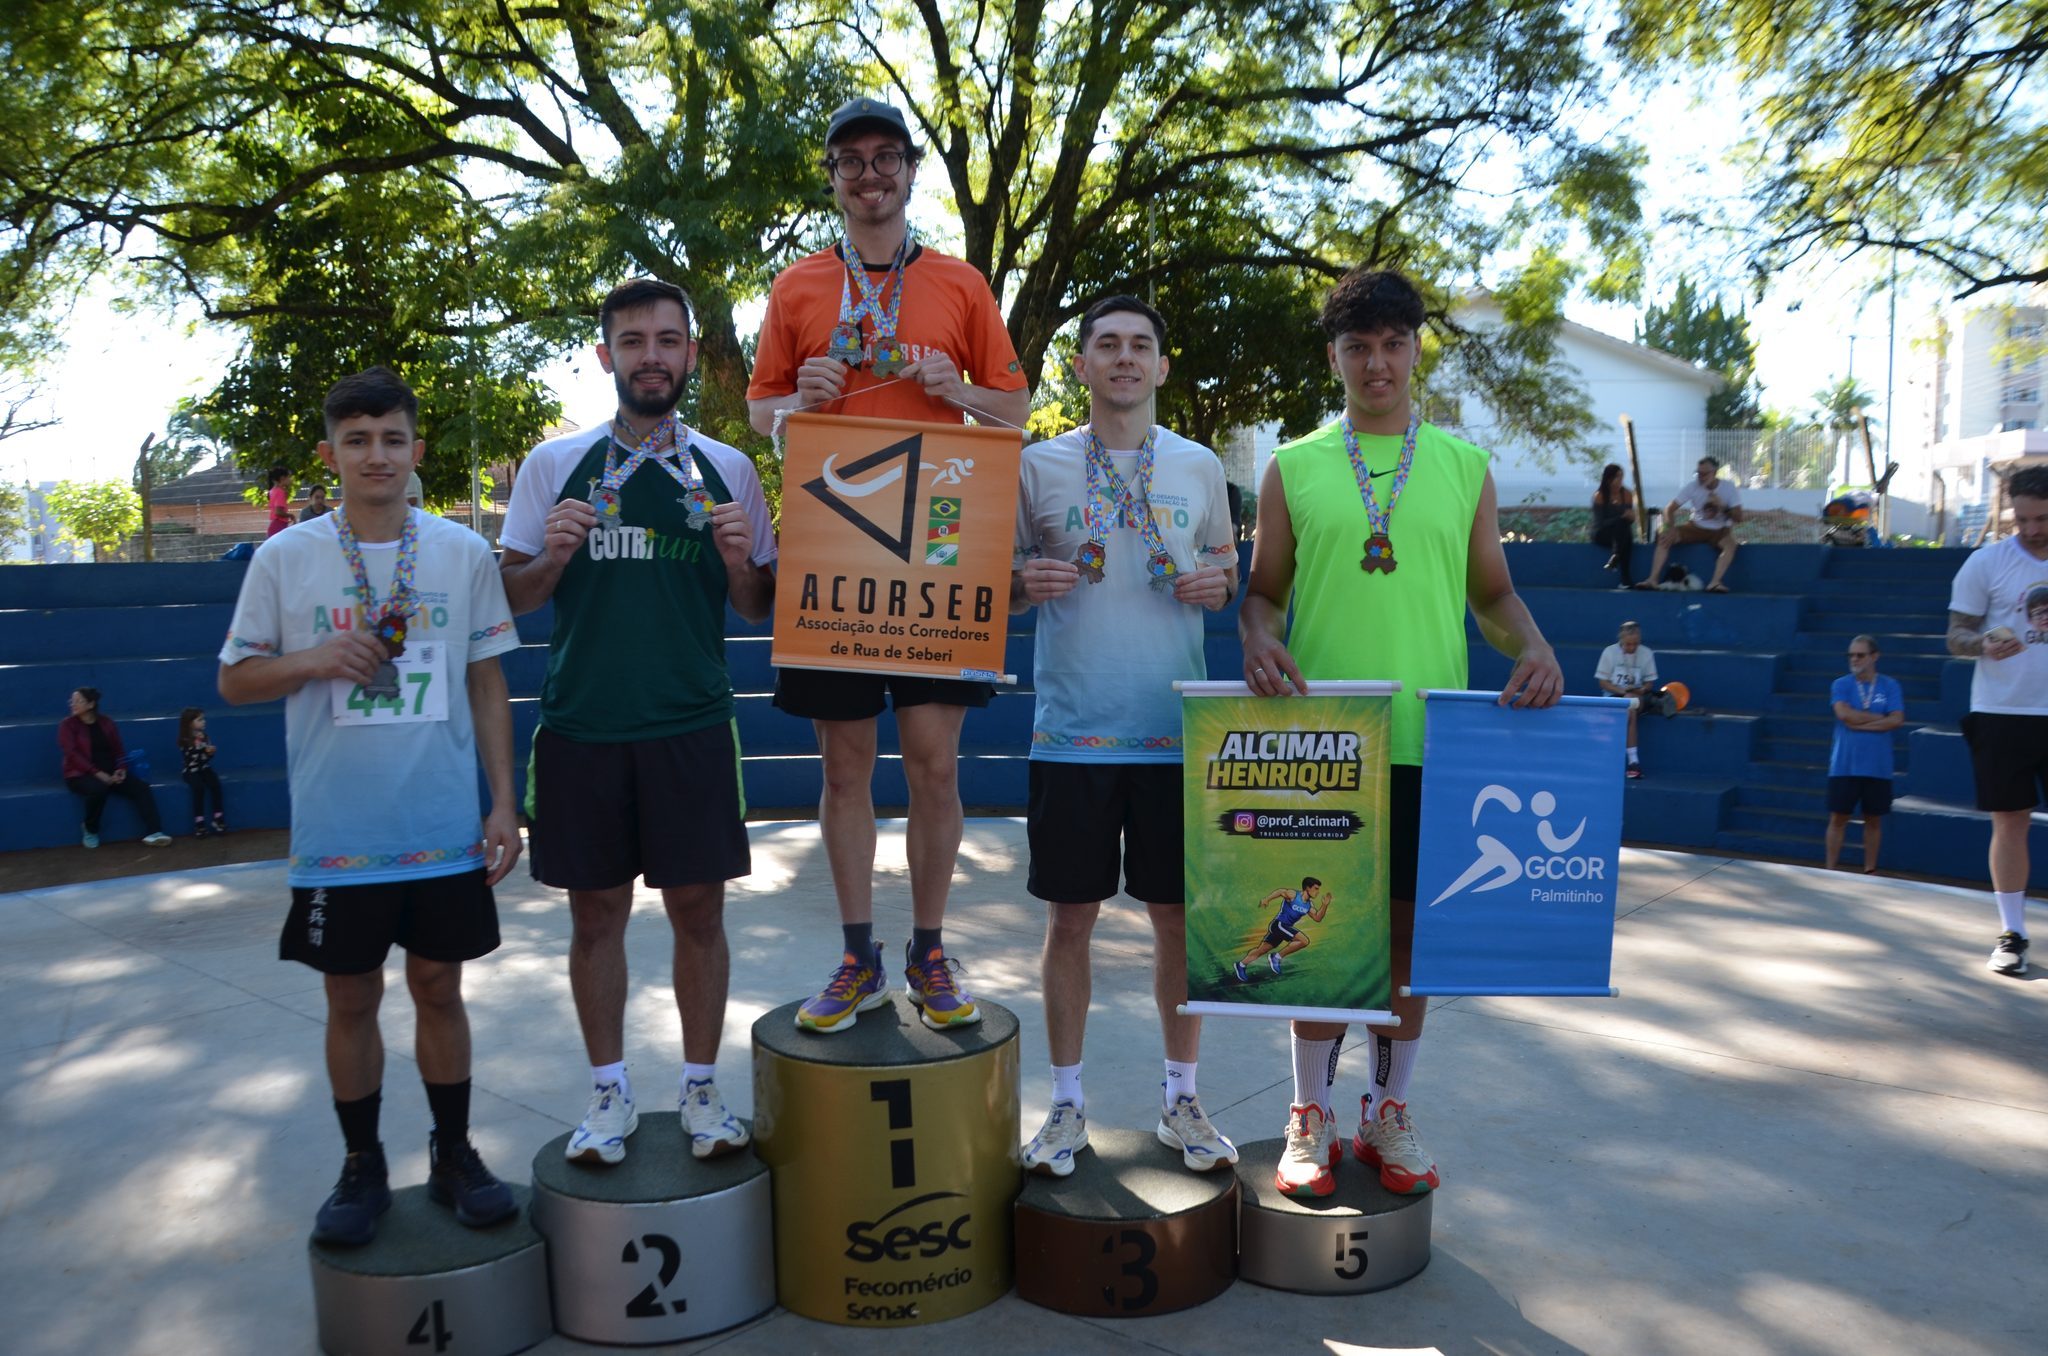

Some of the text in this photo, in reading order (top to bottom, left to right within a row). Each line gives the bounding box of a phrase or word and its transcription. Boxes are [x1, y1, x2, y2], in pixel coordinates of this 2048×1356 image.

[800, 573, 993, 623] ACORSEB
[796, 616, 990, 642] Associação dos Corredores
[830, 641, 953, 662] de Rua de Seberi
[1221, 733, 1358, 760] ALCIMAR
[1211, 762, 1358, 791] HENRIQUE
[1257, 815, 1350, 829] @prof_alcimarh
[1524, 856, 1604, 880] GCOR
[1531, 889, 1603, 904] Palmitinho
[870, 1079, 916, 1189] 1
[844, 1213, 972, 1263] Sesc
[1334, 1231, 1368, 1280] 5
[621, 1234, 687, 1318] 2
[844, 1267, 972, 1296] Fecomércio
[1102, 1230, 1157, 1311] 3
[846, 1301, 918, 1321] Senac
[407, 1300, 453, 1353] 4
